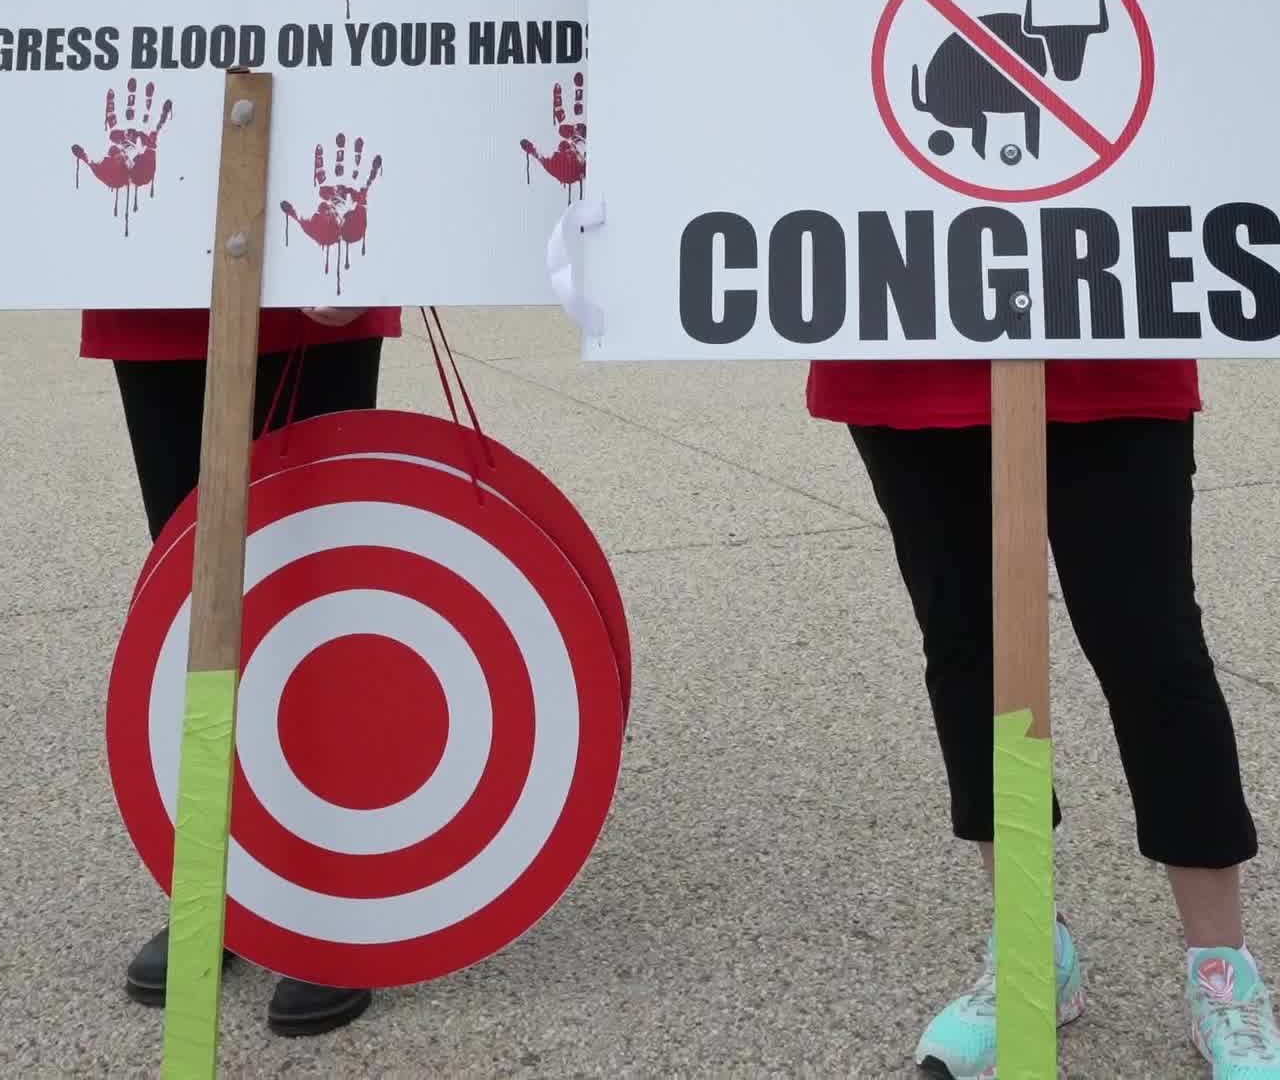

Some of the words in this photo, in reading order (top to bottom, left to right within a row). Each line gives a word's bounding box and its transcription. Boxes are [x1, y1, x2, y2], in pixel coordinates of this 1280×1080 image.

[131, 24, 265, 69] BLOOD
[278, 24, 332, 67] ON
[345, 22, 455, 66] YOUR
[469, 21, 589, 64] HAND
